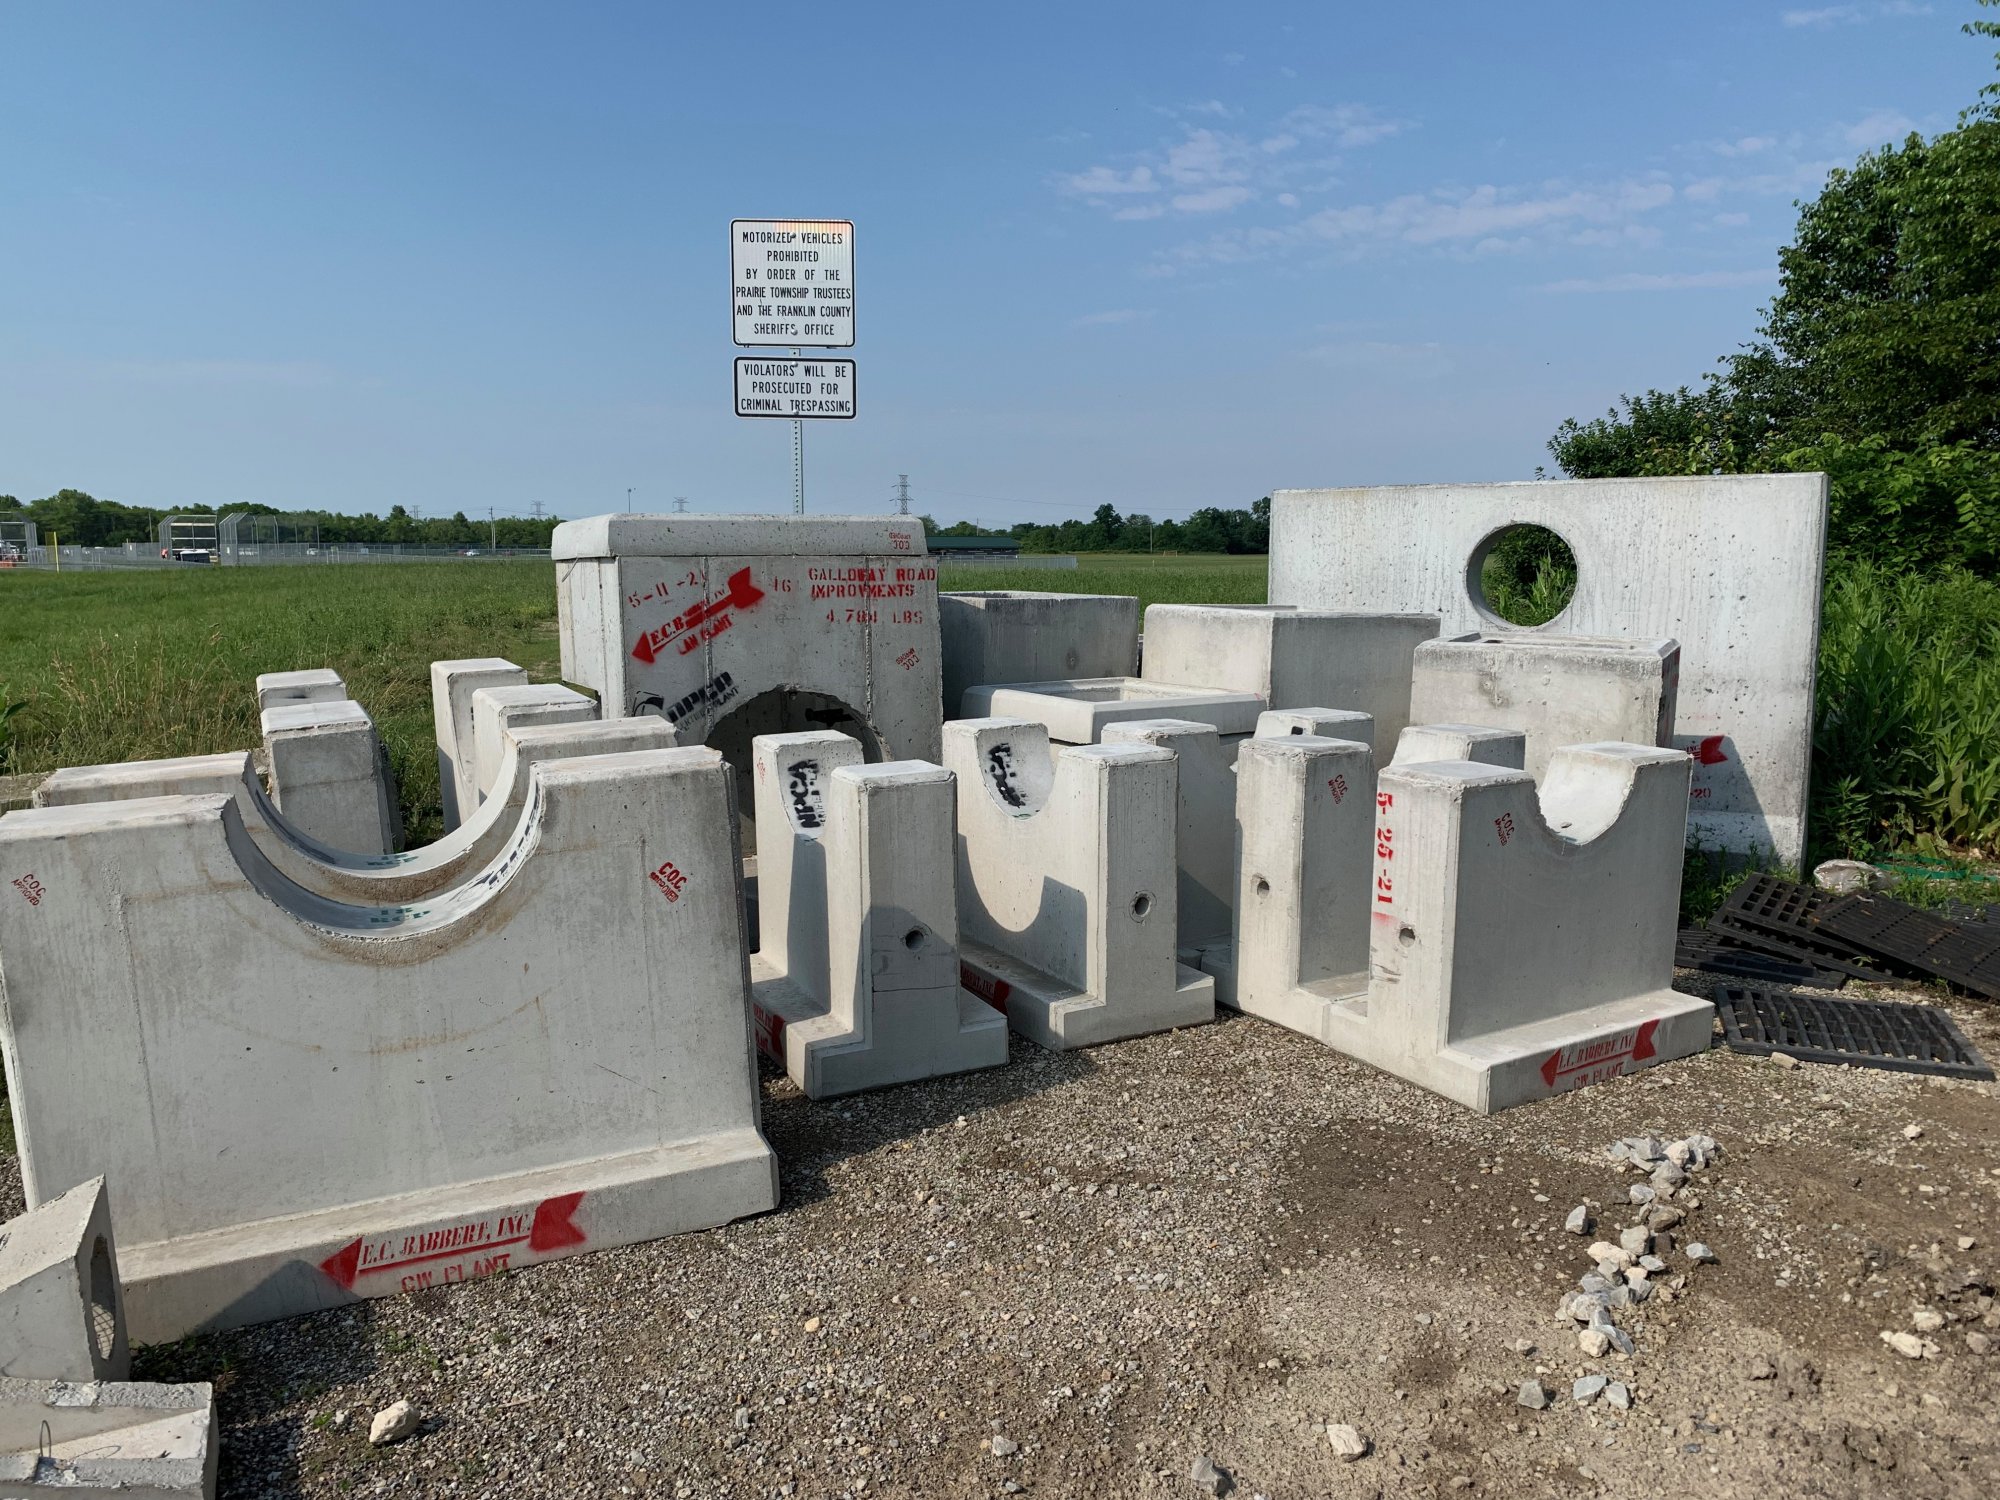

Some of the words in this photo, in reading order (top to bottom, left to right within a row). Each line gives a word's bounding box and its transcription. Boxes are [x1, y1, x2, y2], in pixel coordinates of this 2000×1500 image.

[742, 231, 794, 244] MOTORIZED
[801, 233, 843, 245] VEHICLES
[767, 250, 819, 262] PROHIBITED
[746, 268, 758, 280] BY
[767, 268, 796, 280] ORDER
[804, 269, 815, 281] OF
[824, 269, 841, 281] THE
[736, 286, 766, 298] PRAIRIE
[770, 287, 809, 299] TOWNSHIP
[813, 288, 851, 300] TRUSTEES
[736, 305, 753, 316] AND
[758, 305, 773, 316] THE
[777, 305, 816, 317] FRANKLIN
[820, 306, 851, 318] COUNTY
[804, 324, 835, 336] OFFICE
[744, 364, 796, 377] VIOLATORS
[804, 365, 826, 377] WILL
[835, 366, 847, 378] BE
[752, 382, 812, 394] PROSECUTED
[820, 383, 839, 395] FOR
[741, 399, 782, 411] CRIMINAL
[790, 399, 851, 412] TRESPASSING
[808, 567, 887, 582] GALLOWAY
[896, 567, 936, 581] ROAD
[893, 609, 923, 624] LBS
[1593, 1061, 1625, 1083] PLANT
[361, 1238, 395, 1266] E.C.
[497, 1212, 532, 1238] INC.
[444, 1252, 512, 1282] PLANT
